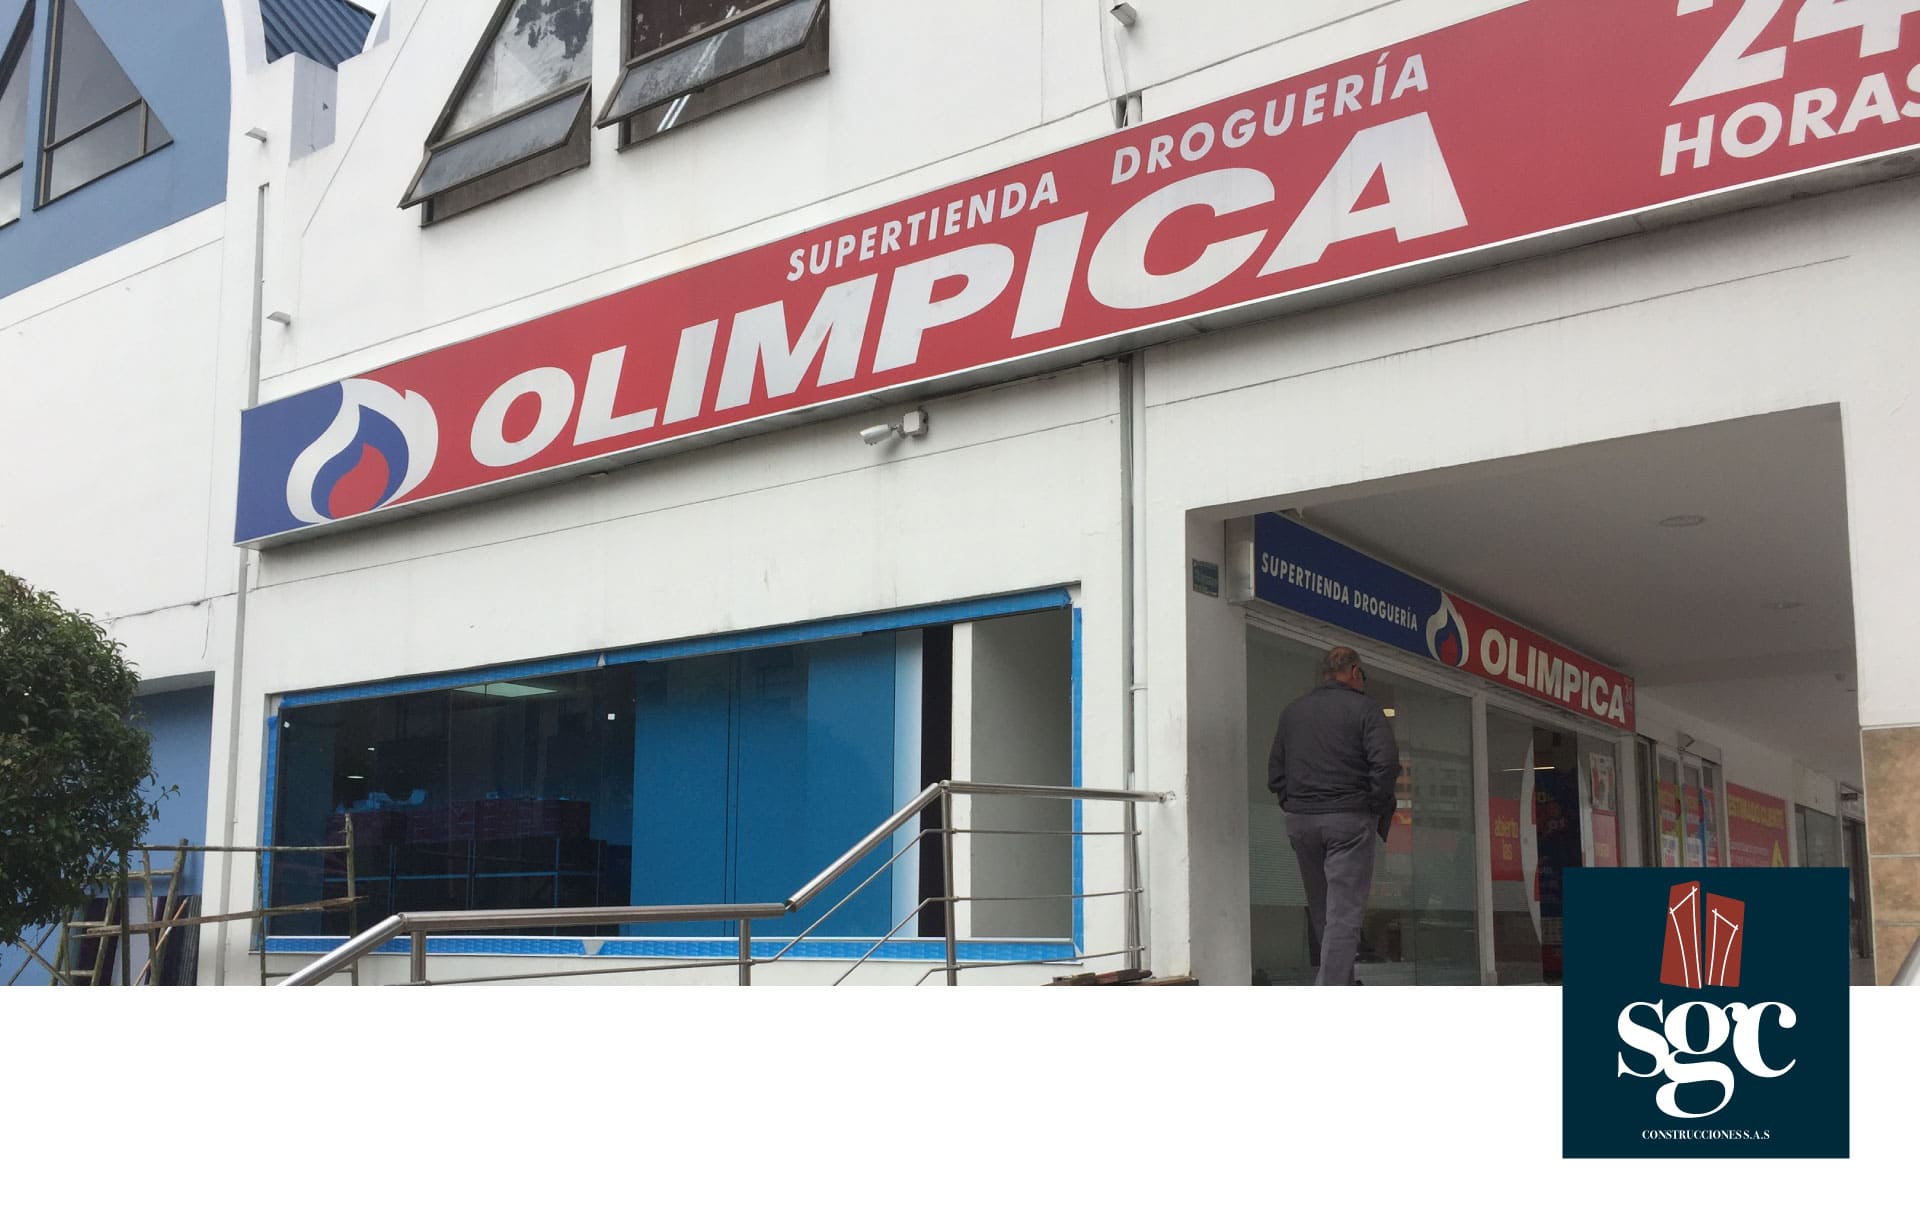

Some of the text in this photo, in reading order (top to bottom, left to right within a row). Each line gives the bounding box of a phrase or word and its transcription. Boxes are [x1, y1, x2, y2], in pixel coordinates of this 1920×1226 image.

[786, 51, 1430, 282] SUPERTIENDA DROGUERÍA
[470, 111, 1469, 468] OLIMPICA
[1261, 551, 1350, 605] SUPERTIENDA
[1353, 589, 1418, 632] DROGUERÍA
[1480, 628, 1626, 724] OLIMPICA
